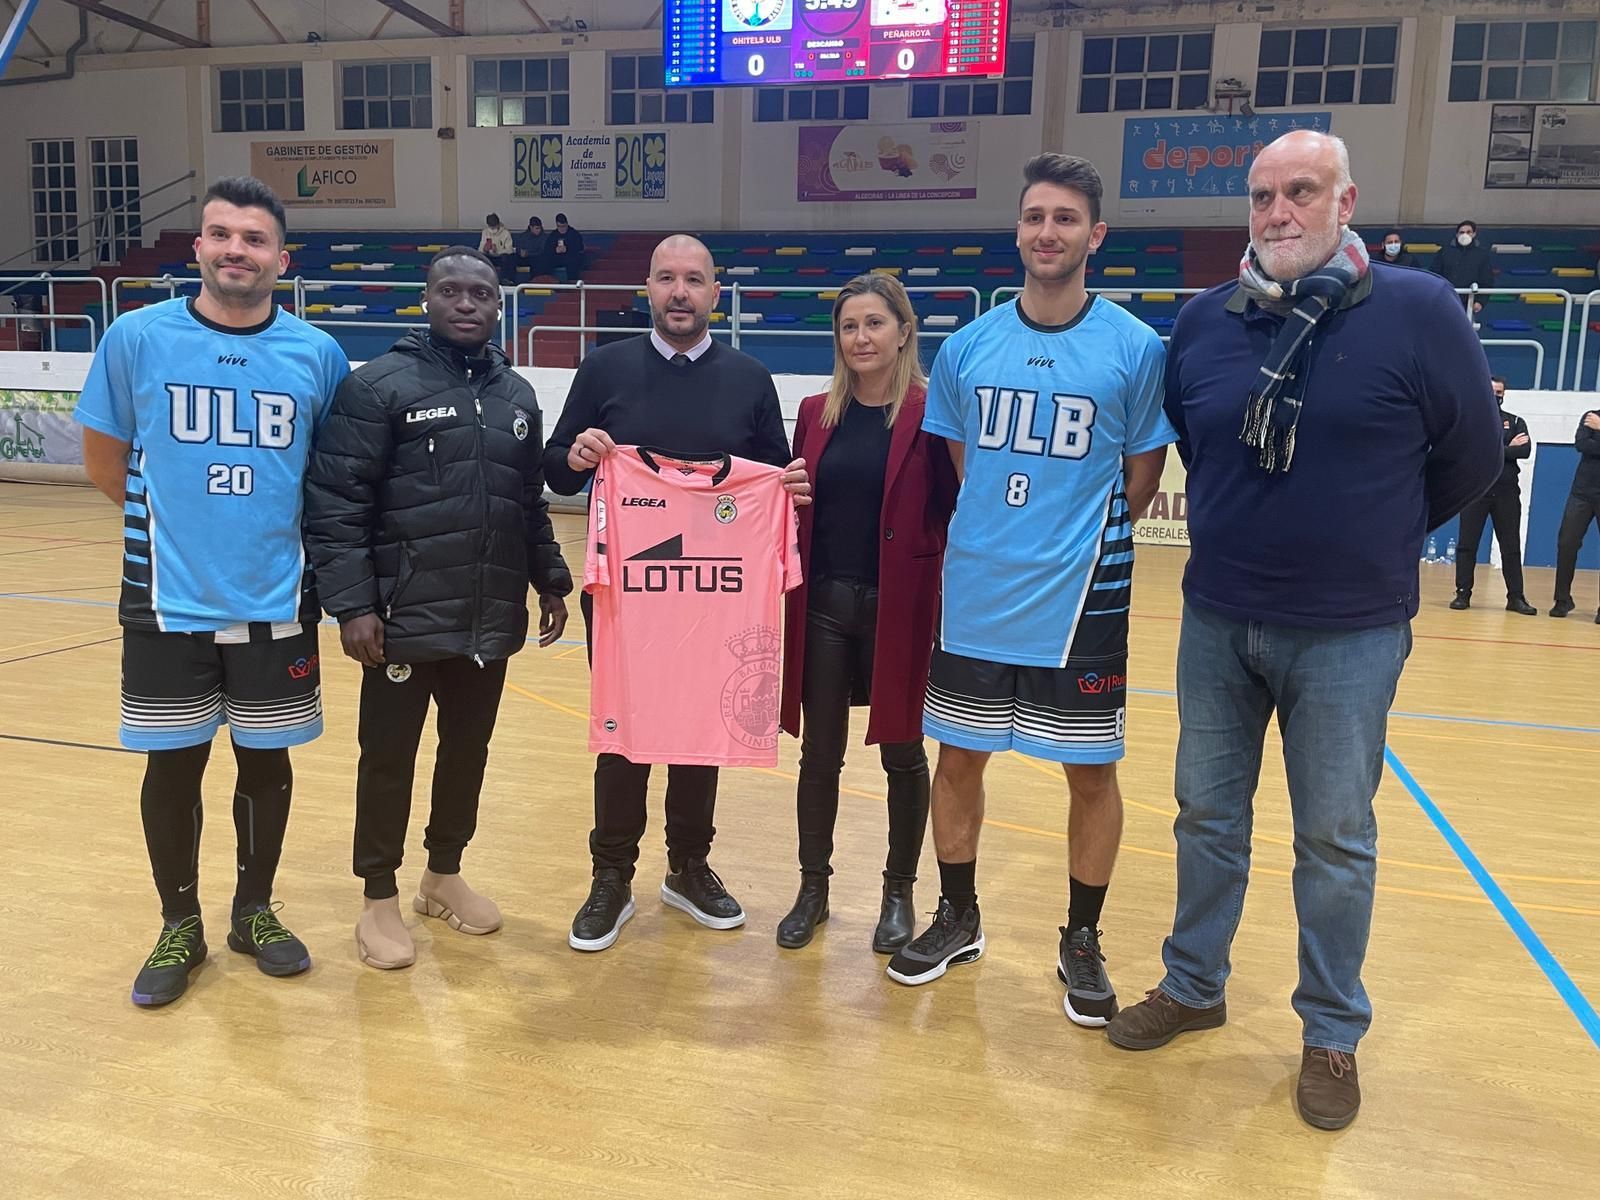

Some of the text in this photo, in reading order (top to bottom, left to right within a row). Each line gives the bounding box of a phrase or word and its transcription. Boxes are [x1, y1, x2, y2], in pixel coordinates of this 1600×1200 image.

[883, 29, 931, 38] PEÑARROYA
[748, 54, 764, 76] 0
[897, 48, 915, 71] 0
[266, 143, 379, 156] GABINETE DE GESTIÓN
[566, 135, 610, 146] Academia
[514, 137, 540, 186] BC
[570, 160, 606, 170] Idiomas
[582, 149, 593, 159] de
[616, 136, 642, 186] BC
[543, 183, 562, 198] School
[644, 182, 665, 198] School
[165, 383, 297, 450] ULB
[406, 406, 457, 423] LEGEA
[975, 386, 1097, 461] ULB
[207, 463, 253, 496] 20
[1005, 472, 1030, 507] 8
[622, 497, 667, 508] LEGEA
[1139, 492, 1188, 520] AD
[623, 566, 743, 592] LOTUS
